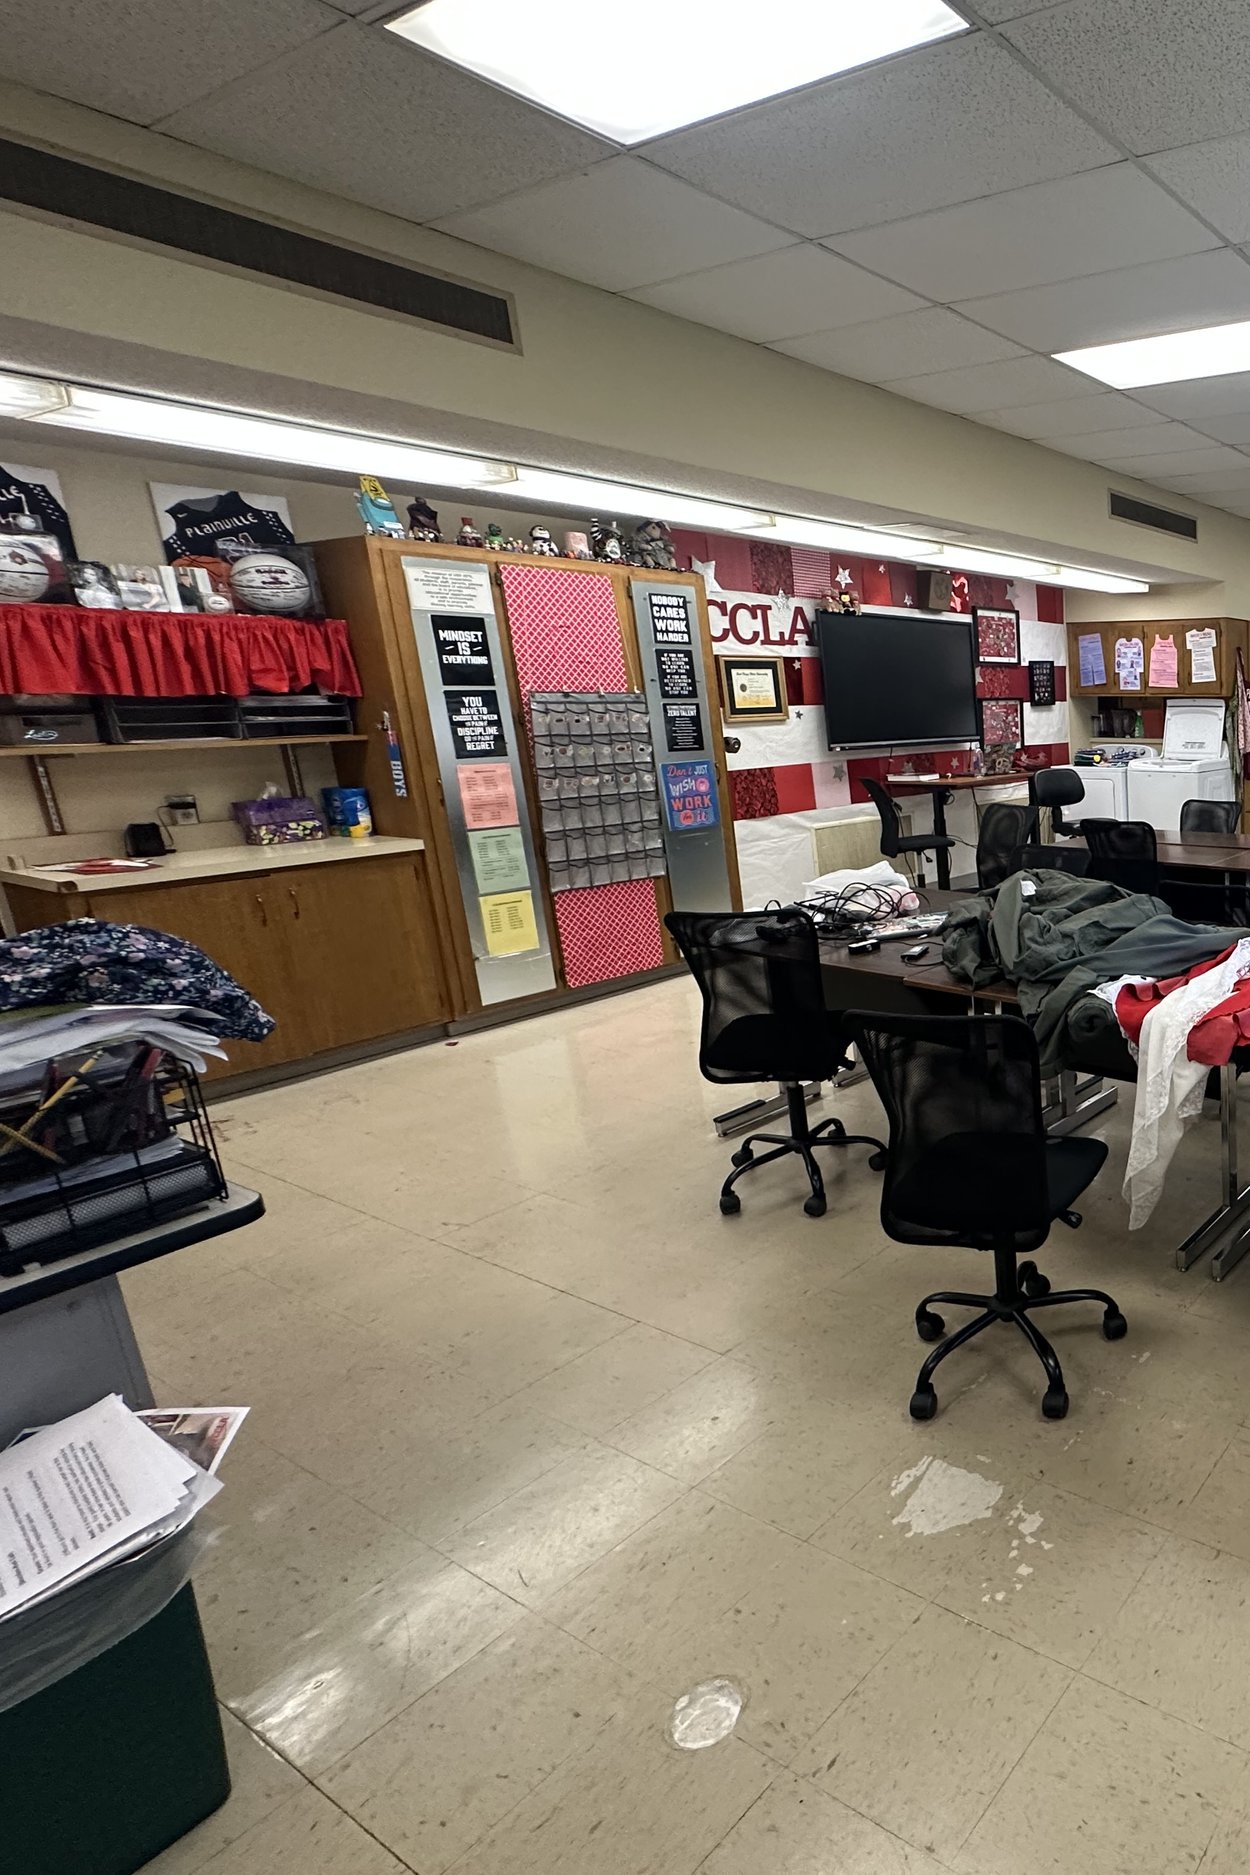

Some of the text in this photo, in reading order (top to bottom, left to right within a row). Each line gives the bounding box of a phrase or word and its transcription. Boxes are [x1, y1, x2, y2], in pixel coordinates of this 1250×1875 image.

[651, 595, 684, 607] NOBODY
[652, 606, 686, 619] CARES
[653, 618, 688, 632] WORK
[438, 629, 483, 642] MINDSET
[656, 631, 689, 642] HARDER
[456, 641, 471, 655] IS
[442, 654, 489, 665] EVERYTHING
[462, 696, 483, 707] YOU
[460, 707, 488, 715] HAVE TO
[680, 709, 697, 717] TALENT
[456, 726, 499, 736] DISCIPLINE
[465, 741, 495, 751] REGRET
[390, 760, 408, 798] BOYS
[669, 777, 696, 797] WISH
[671, 794, 712, 811] WORK
